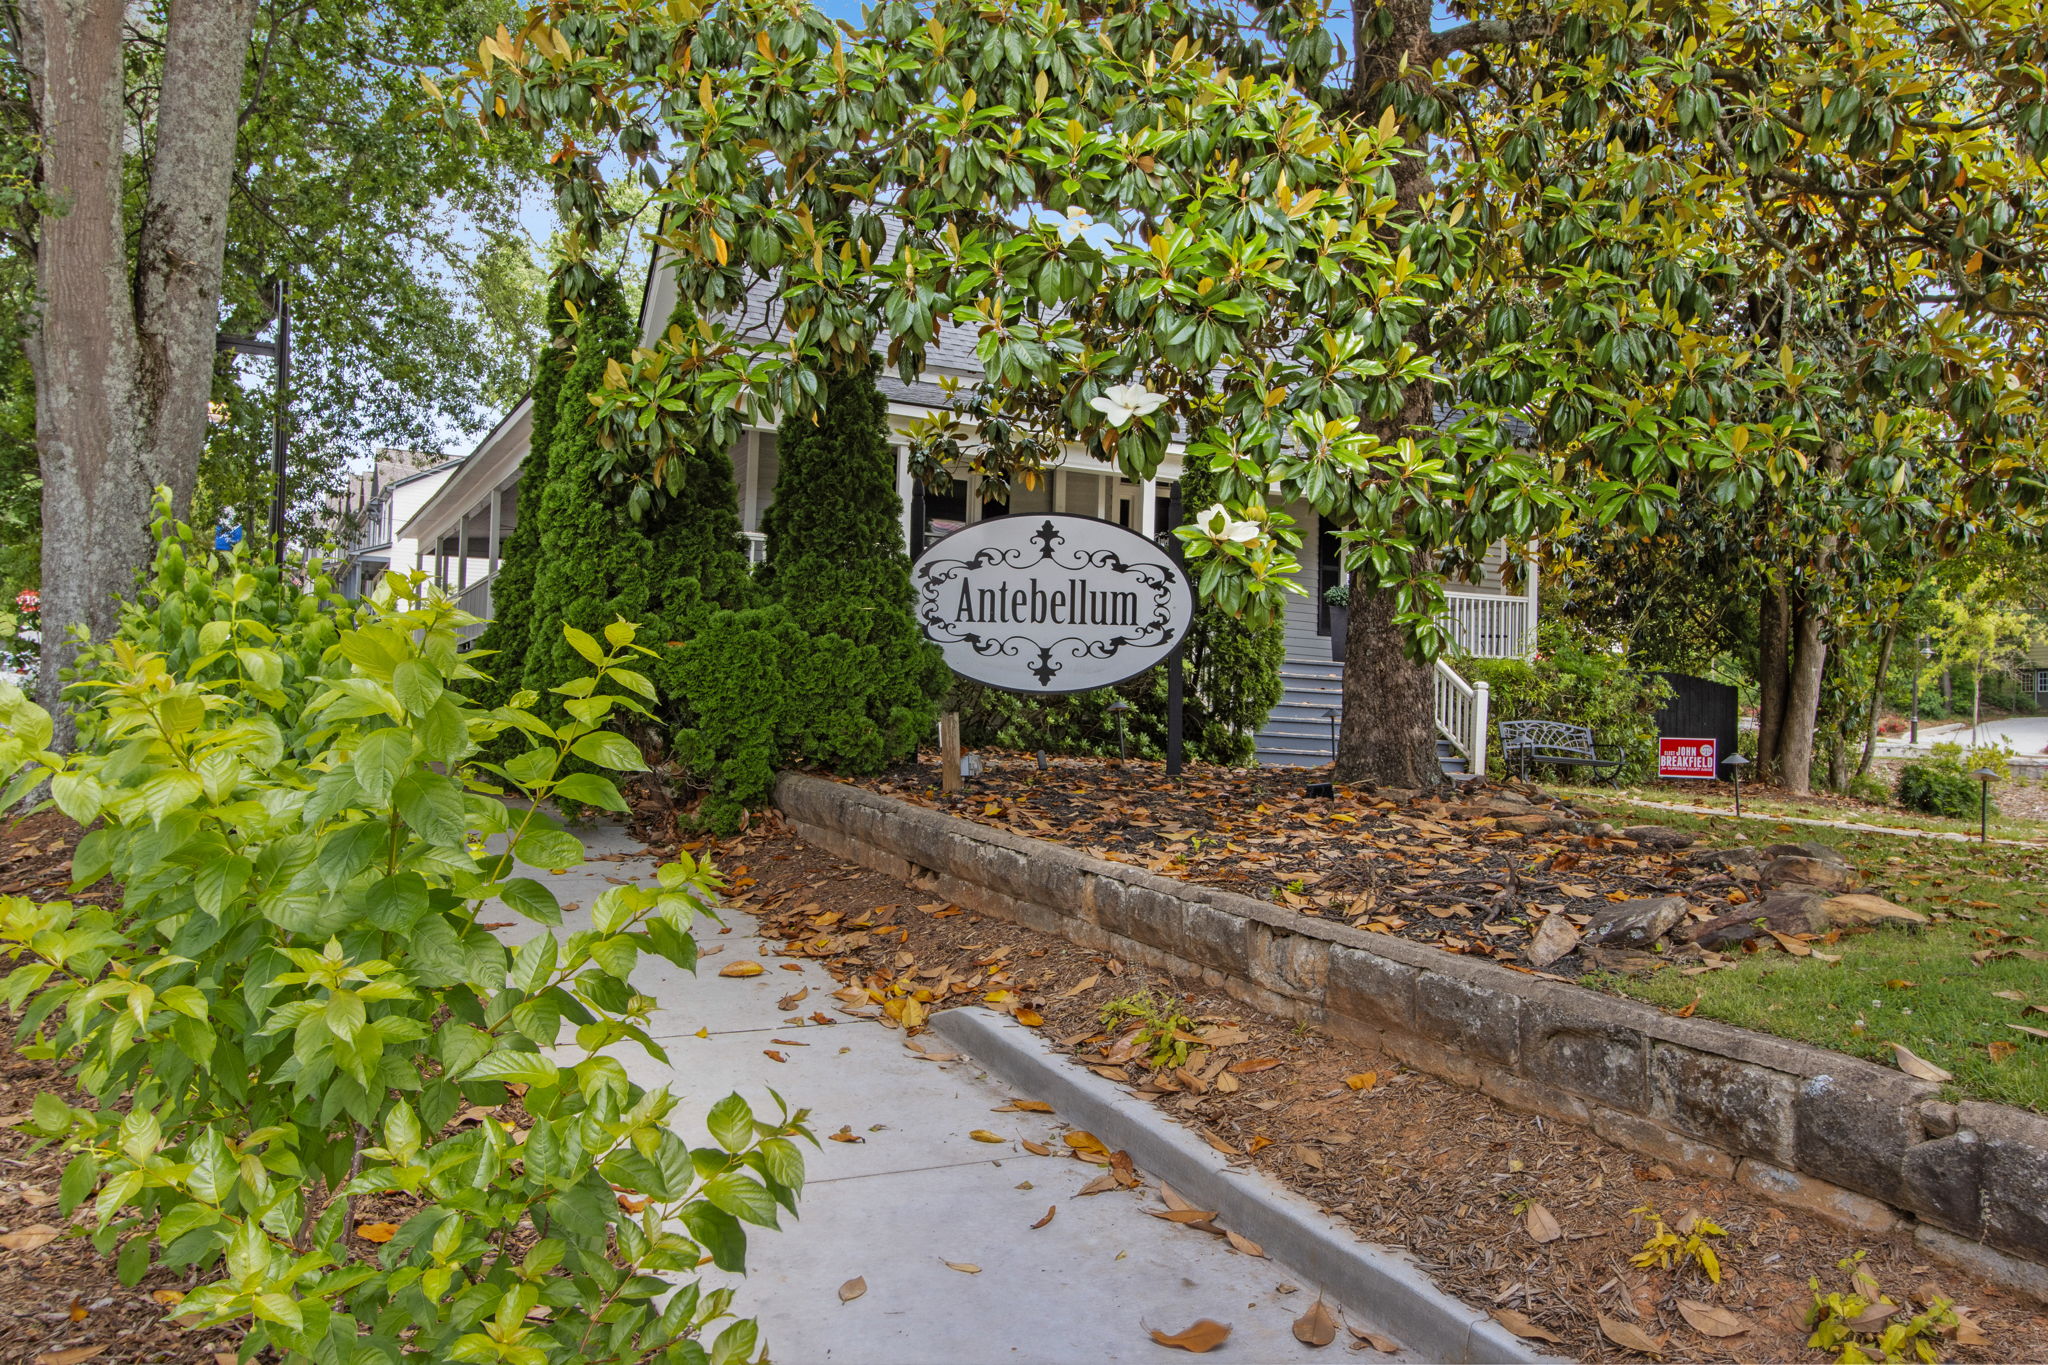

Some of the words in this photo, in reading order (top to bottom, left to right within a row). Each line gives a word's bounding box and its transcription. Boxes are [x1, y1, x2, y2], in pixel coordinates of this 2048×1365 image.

[955, 577, 1138, 625] Antebellum
[1676, 747, 1697, 756] JOHN
[1661, 756, 1713, 768] BREAKFIELD
